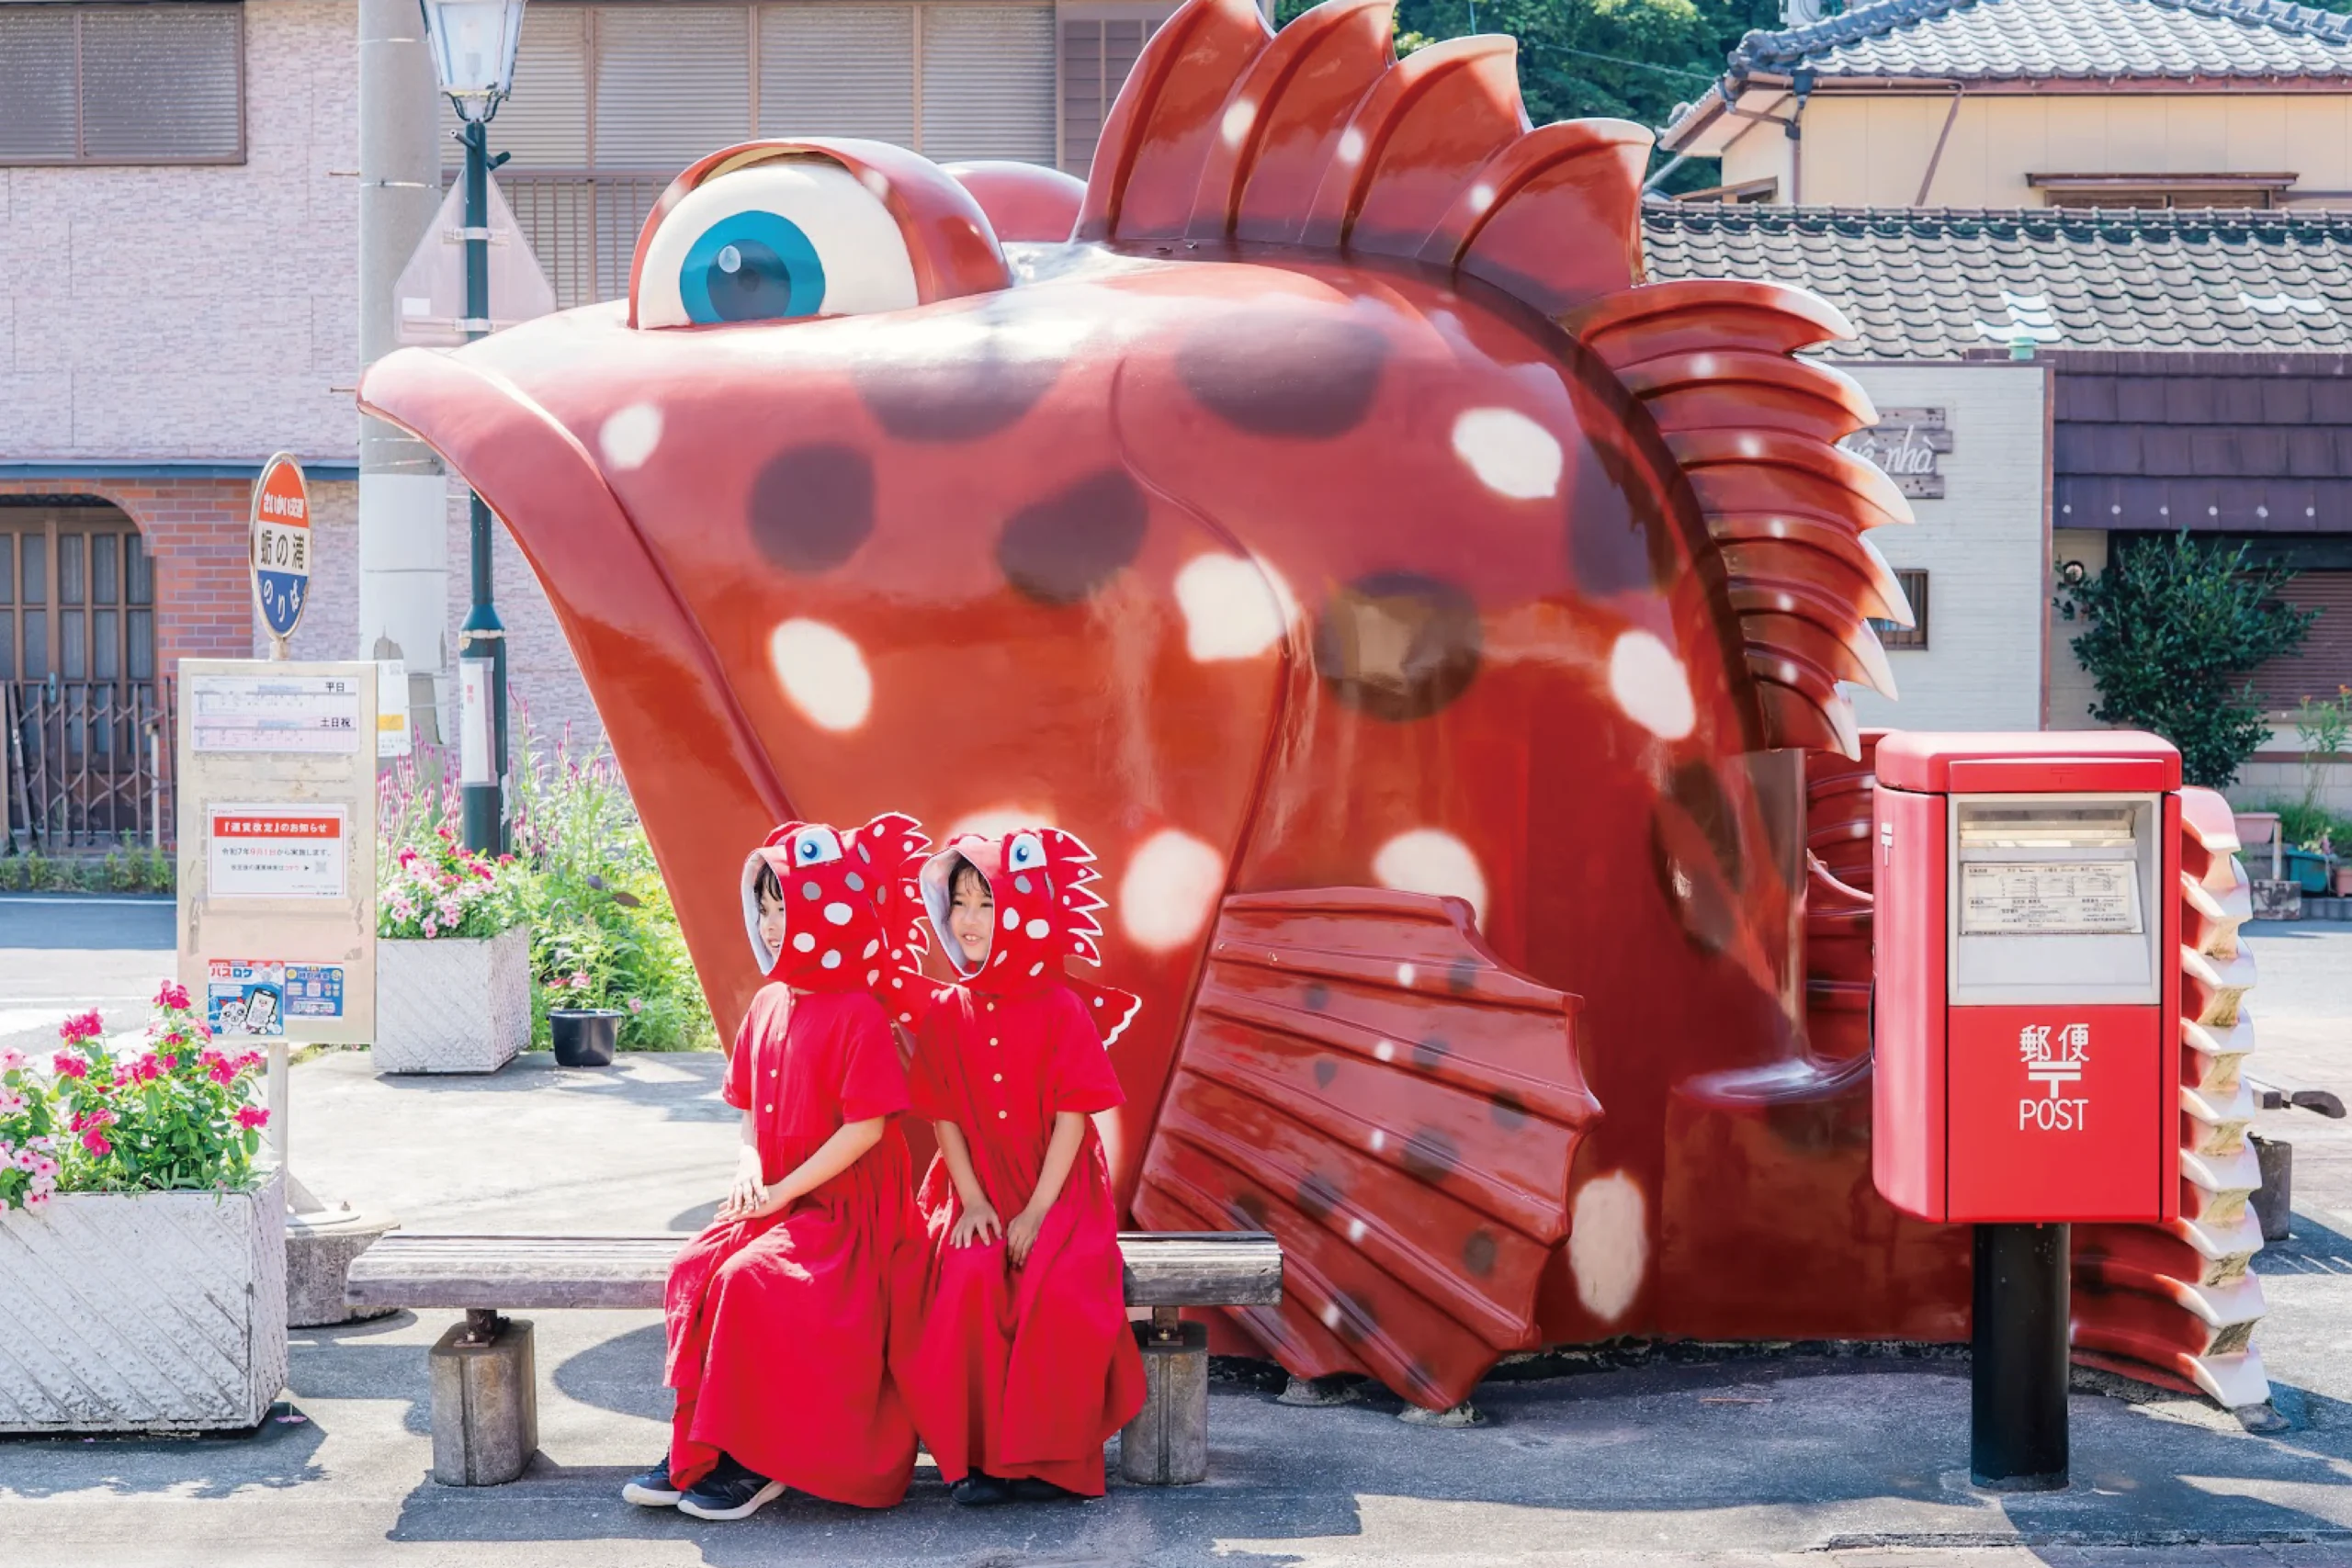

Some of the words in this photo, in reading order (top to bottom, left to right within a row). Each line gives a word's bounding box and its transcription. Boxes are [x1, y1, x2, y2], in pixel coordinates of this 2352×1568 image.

[1884, 424, 1935, 473] nhà
[263, 491, 304, 518] さいかい交通
[263, 579, 300, 623] のりば
[326, 682, 345, 693] 平日
[320, 717, 351, 728] 土日祝
[2019, 1023, 2089, 1063] 郵便
[2019, 1099, 2089, 1131] POST
